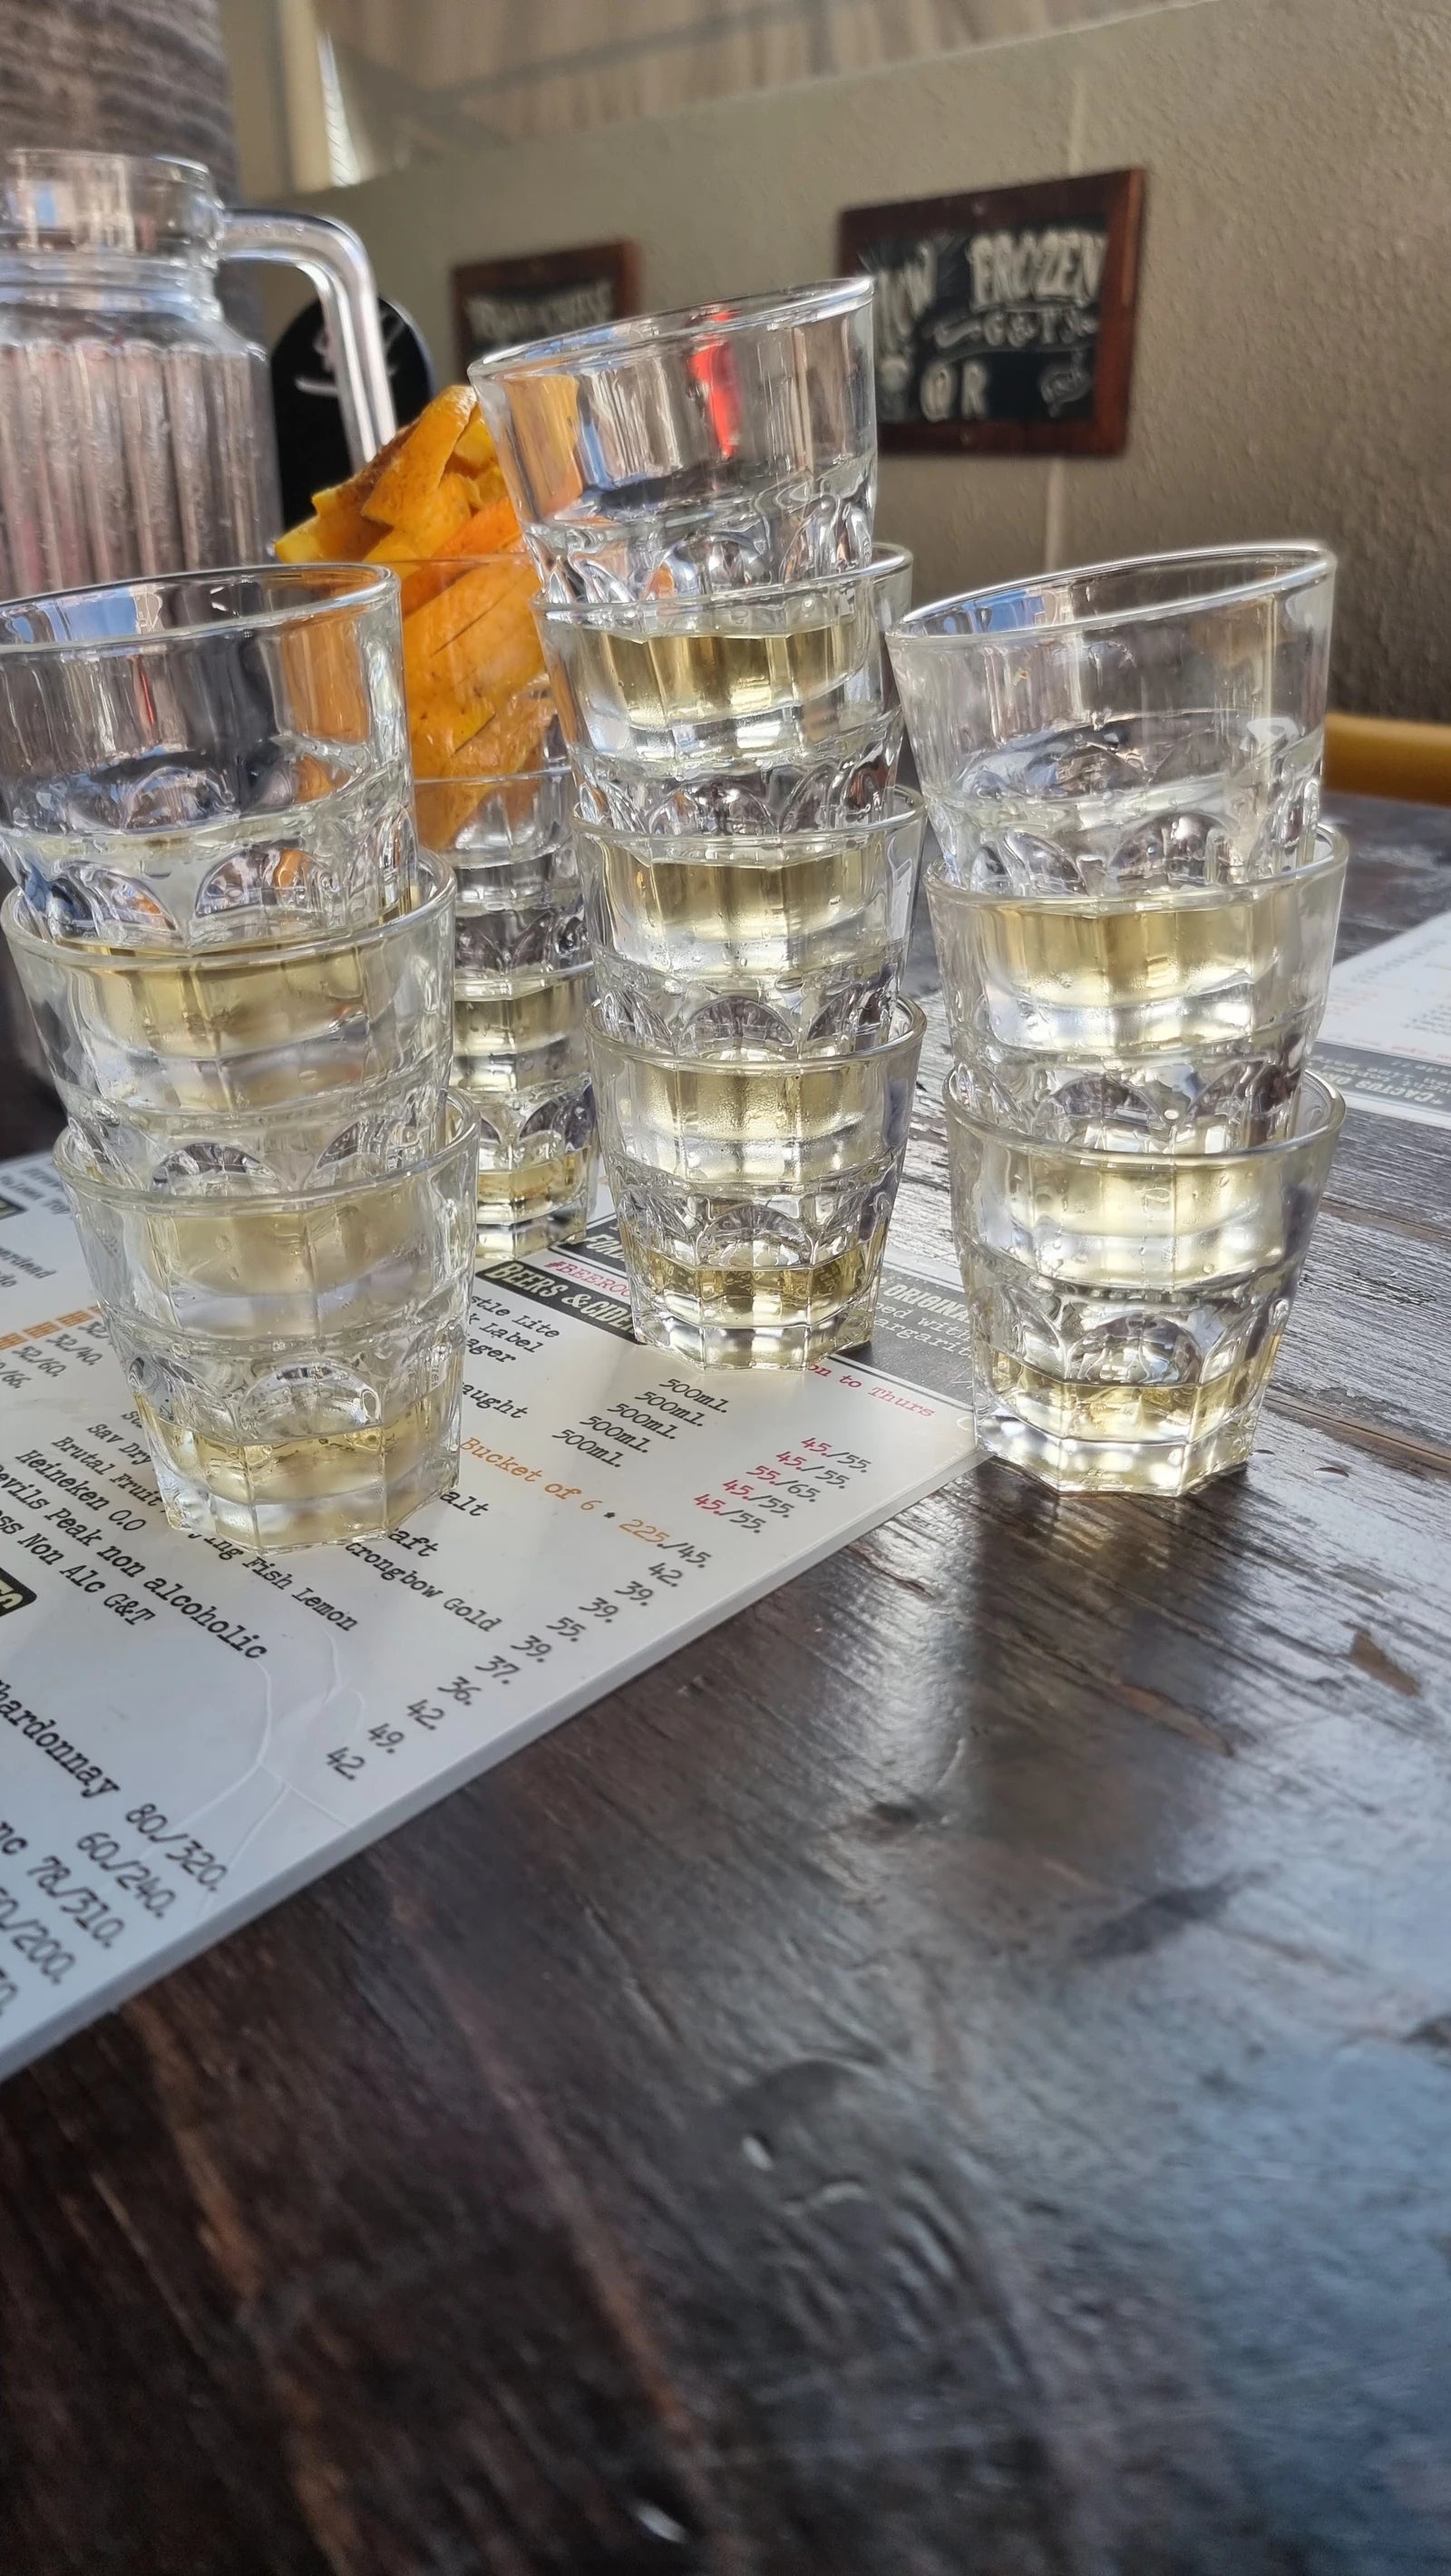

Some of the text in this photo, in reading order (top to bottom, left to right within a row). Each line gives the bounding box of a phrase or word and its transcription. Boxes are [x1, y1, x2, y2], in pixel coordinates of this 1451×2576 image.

[969, 228, 1108, 313] FROZEN
[484, 1262, 569, 1298] BEERS
[471, 1296, 560, 1337] stle Lite
[466, 1337, 517, 1363] ager
[479, 1323, 544, 1353] Label
[874, 1318, 972, 1359] argarit
[462, 1383, 529, 1419] aught
[634, 1391, 705, 1426] 500ml.
[658, 1378, 728, 1413] 500ml.
[839, 1375, 862, 1388] to
[868, 1386, 935, 1417] Thurs
[579, 1415, 650, 1453] 500ml.
[607, 1403, 677, 1440] 500ml.
[87, 1424, 152, 1465] Sav Dry
[551, 1429, 623, 1468] 500ml.
[801, 1437, 872, 1473] 45./55.
[52, 1436, 163, 1507] Brutal Fruit
[460, 1437, 542, 1482] Bucket
[544, 1482, 582, 1501] of
[579, 1499, 603, 1512] 6
[745, 1465, 821, 1502] 55./65.
[15, 1450, 147, 1531] Heineken 0.0
[439, 1490, 489, 1517] alt
[723, 1479, 794, 1519] 45./55.
[694, 1493, 766, 1533] 45./55.
[387, 1528, 439, 1557] aft
[0, 1464, 268, 1659] evils Peak non alcoholic
[17, 1532, 64, 1566] Non
[59, 1564, 106, 1593] Alc
[103, 1593, 156, 1626] G&T
[648, 1562, 683, 1587] 42.
[242, 1556, 293, 1590] Fish
[291, 1587, 358, 1631] Lemon
[345, 1541, 502, 1632] trongbow Gold
[614, 1580, 653, 1606] 39.
[579, 1597, 618, 1623] 39.
[546, 1617, 587, 1642] 55.
[510, 1635, 551, 1663] 39.
[474, 1656, 521, 1685] 37.
[437, 1677, 482, 1706] 36.
[406, 1699, 445, 1731] 42.
[0, 1680, 121, 1799] hardonnay
[368, 1723, 404, 1754] 49.
[326, 1746, 365, 1781] 42.
[0, 1887, 75, 1985] 0./200.
